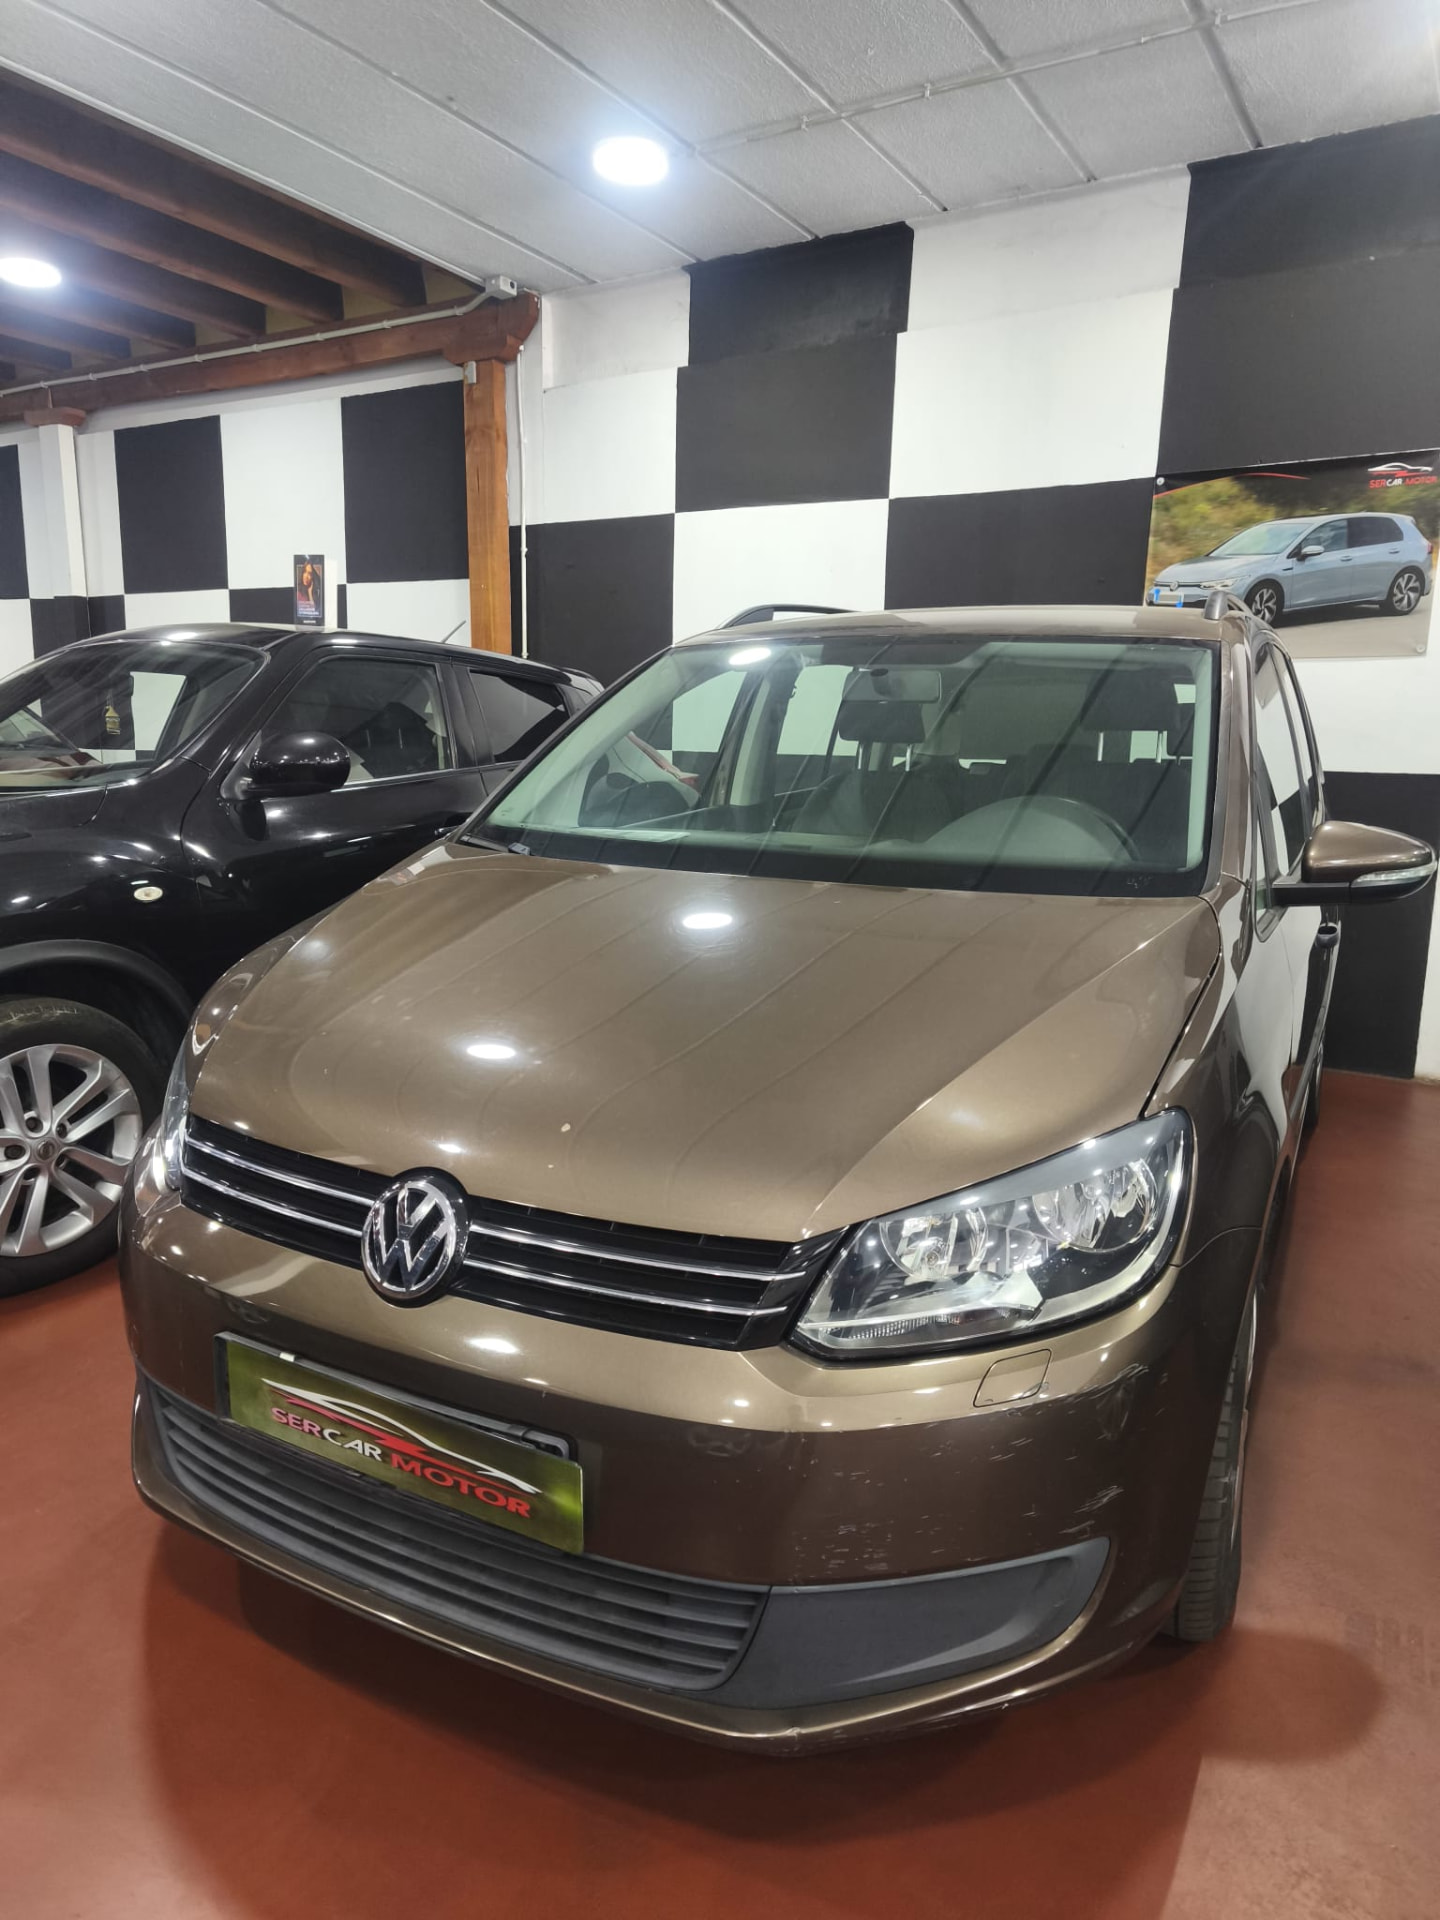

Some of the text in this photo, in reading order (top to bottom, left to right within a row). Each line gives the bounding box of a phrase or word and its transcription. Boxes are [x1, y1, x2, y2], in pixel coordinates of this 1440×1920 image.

[1369, 475, 1437, 489] SERCAR MOTOR
[271, 1407, 531, 1518] SERCAR MOTOR
